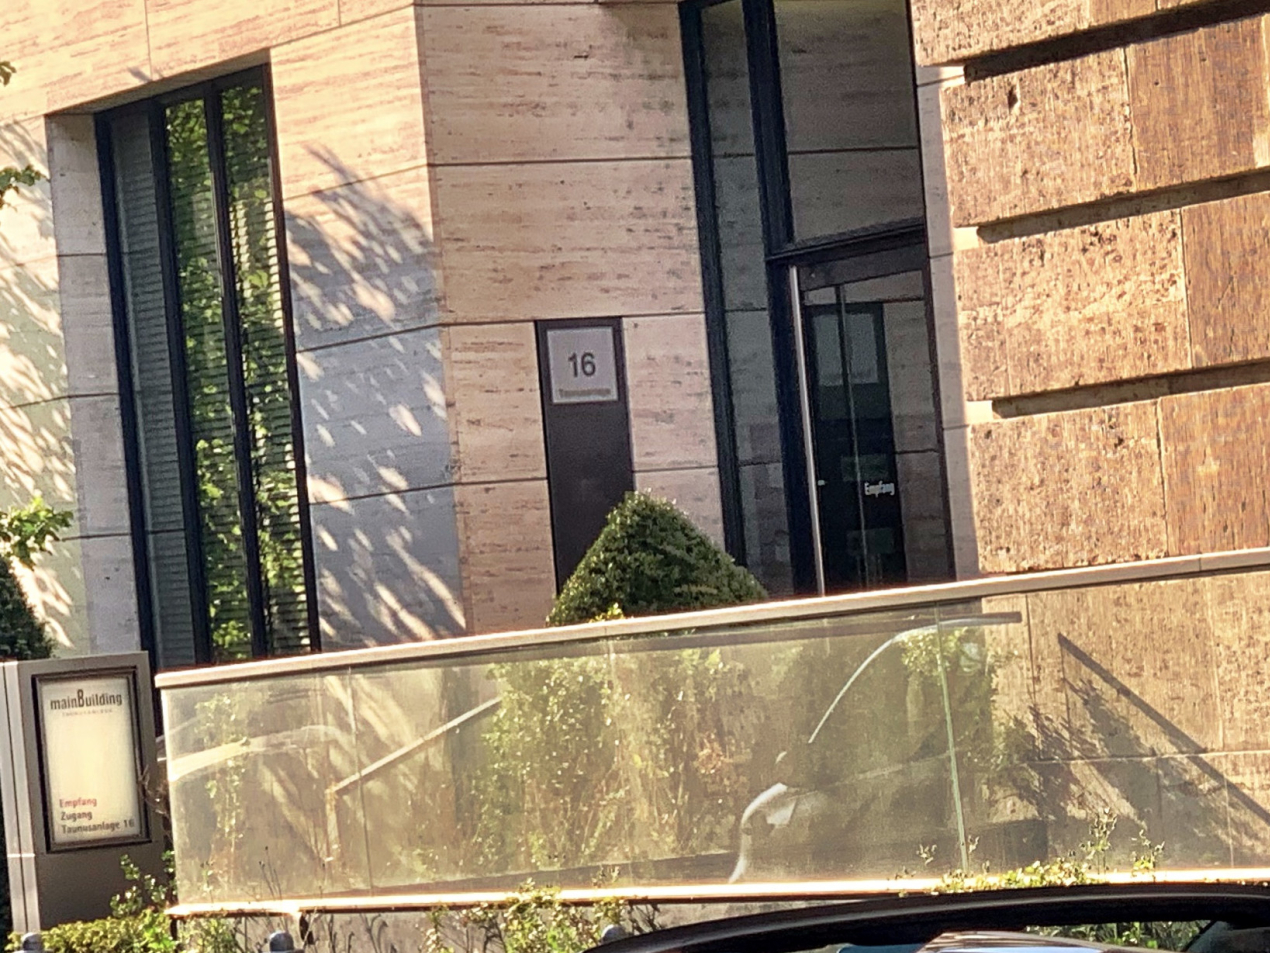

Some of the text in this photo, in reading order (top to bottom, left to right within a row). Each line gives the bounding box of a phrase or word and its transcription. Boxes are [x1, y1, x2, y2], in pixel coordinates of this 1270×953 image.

[567, 352, 596, 378] 16
[50, 689, 122, 710] mainBuilding
[59, 797, 97, 809] Empfang
[61, 811, 93, 822] Zugang
[61, 821, 121, 834] Taunusanlage
